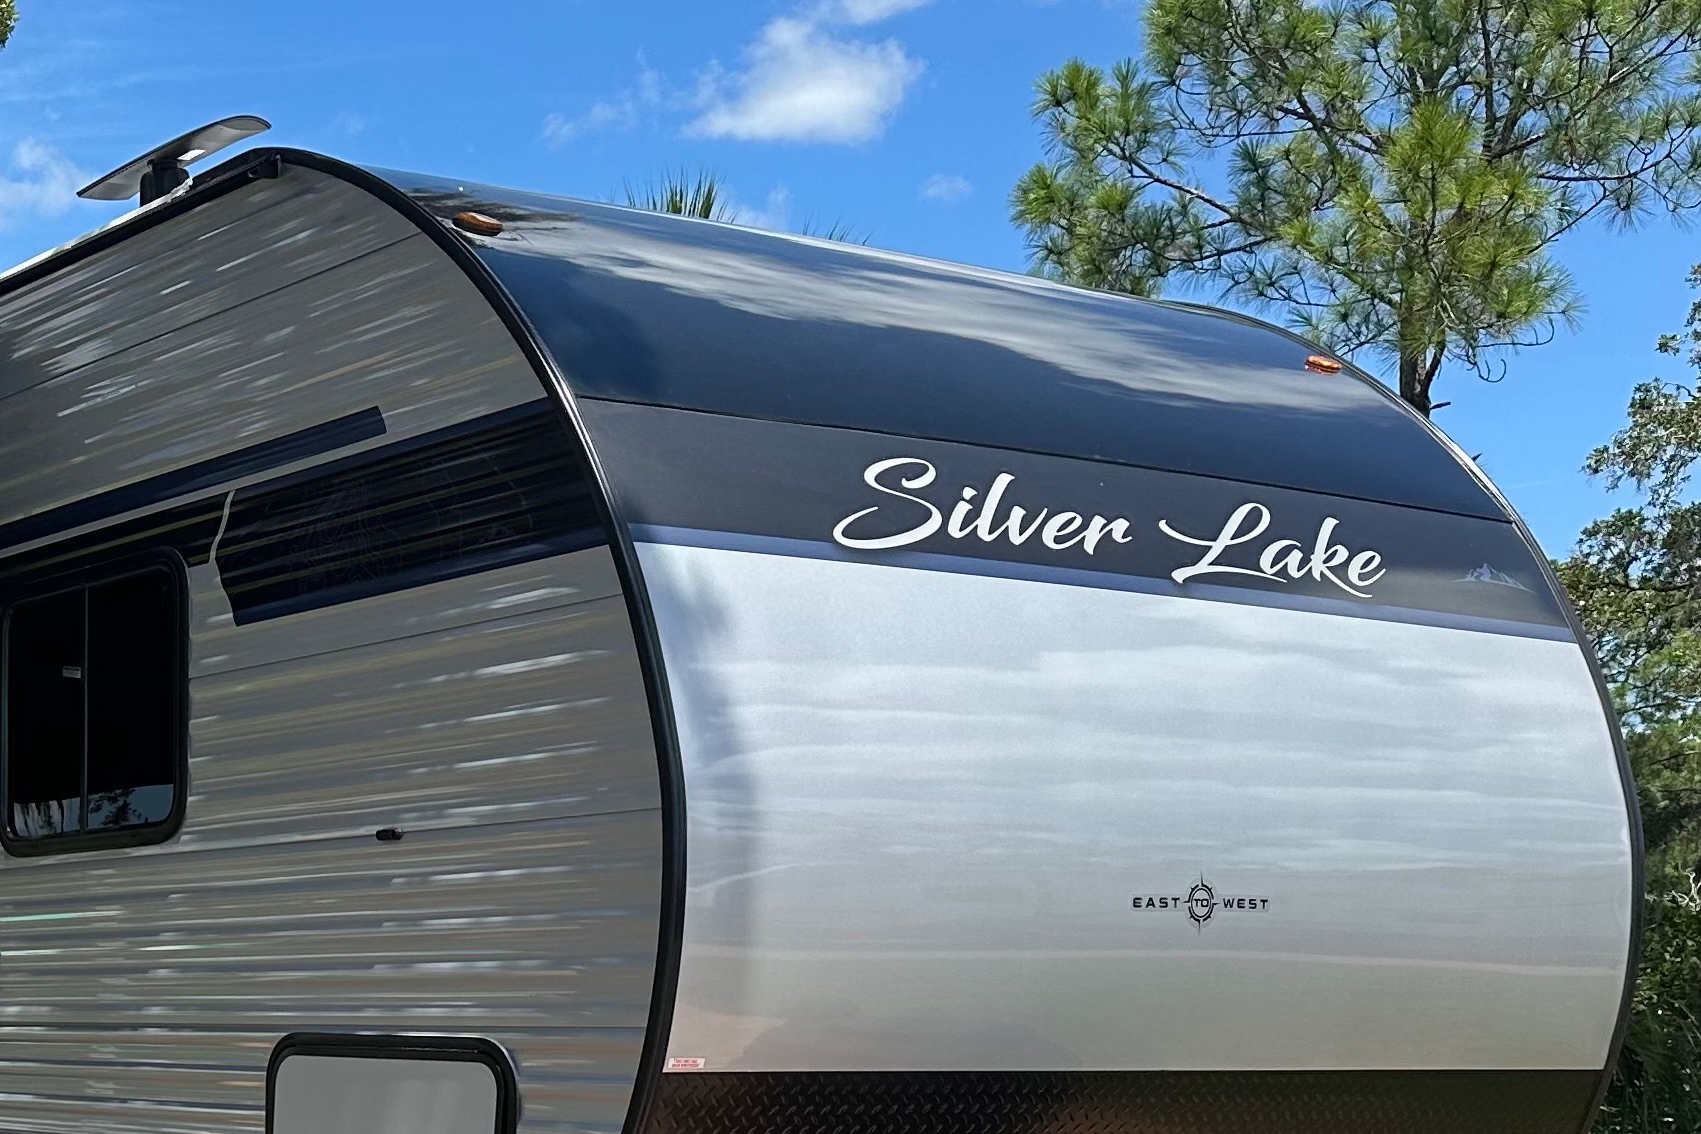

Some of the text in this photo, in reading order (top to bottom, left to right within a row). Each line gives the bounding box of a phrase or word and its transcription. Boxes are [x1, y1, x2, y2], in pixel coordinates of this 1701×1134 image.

[833, 457, 1387, 598] Silver Lake
[1132, 897, 1269, 909] EAST TO WEST
